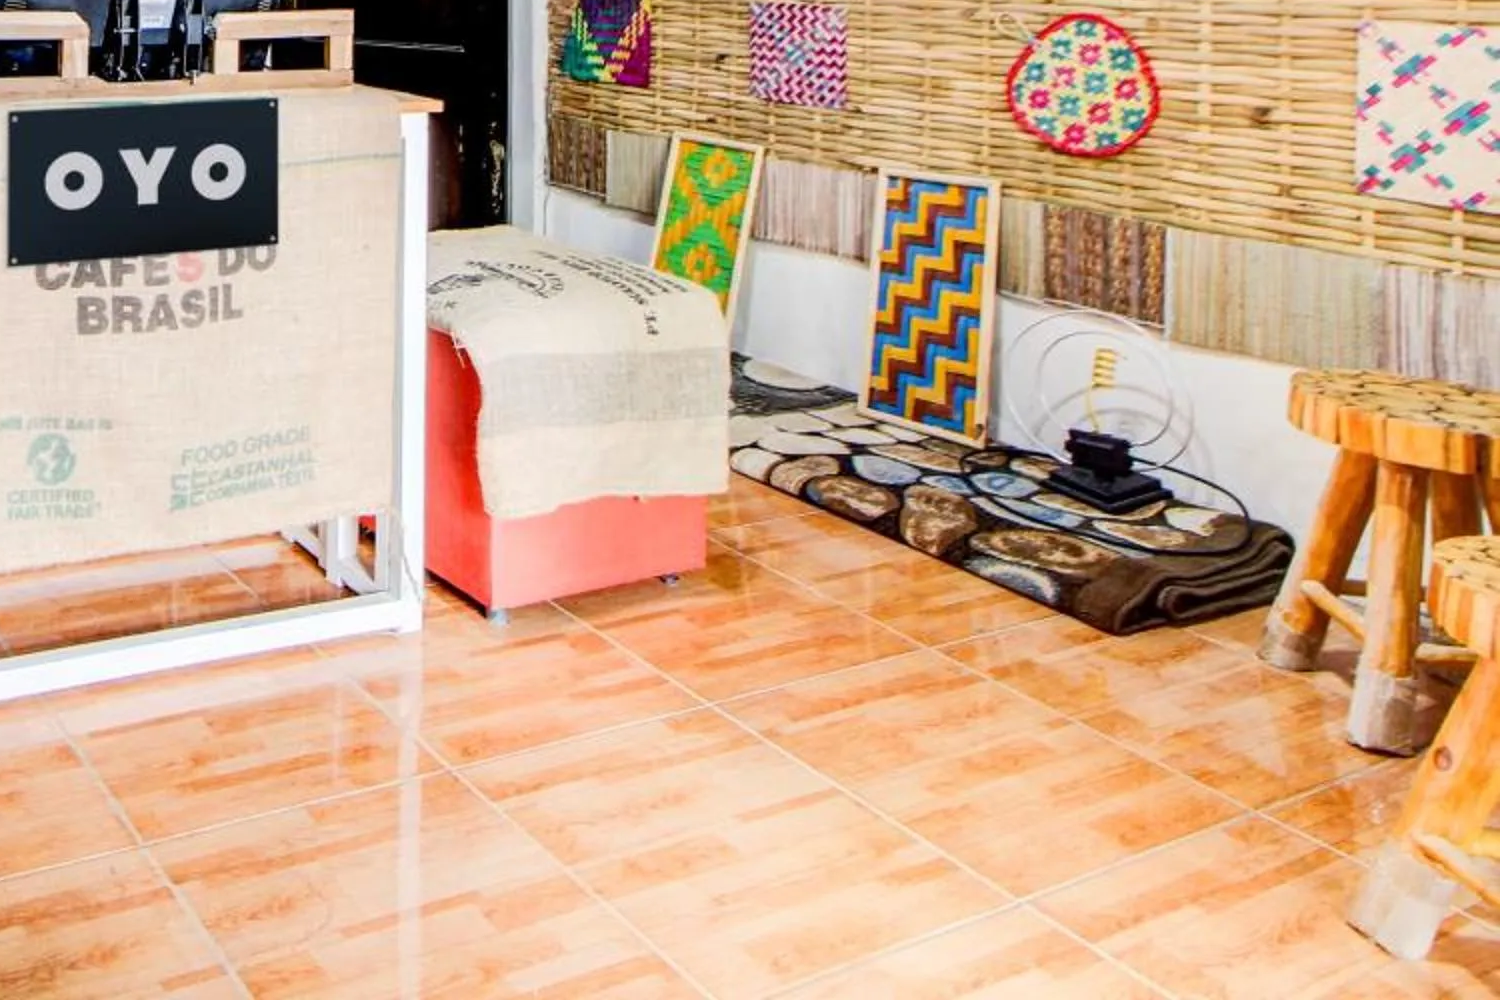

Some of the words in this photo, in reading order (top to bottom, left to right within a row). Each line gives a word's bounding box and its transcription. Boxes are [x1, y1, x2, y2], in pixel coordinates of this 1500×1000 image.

[44, 143, 247, 211] OYO
[218, 245, 276, 276] DO
[77, 284, 243, 335] BRASIL
[181, 439, 238, 466] FOOD
[244, 425, 310, 453] GRADE
[6, 488, 95, 504] CERTIFIED
[7, 505, 38, 519] FAIR
